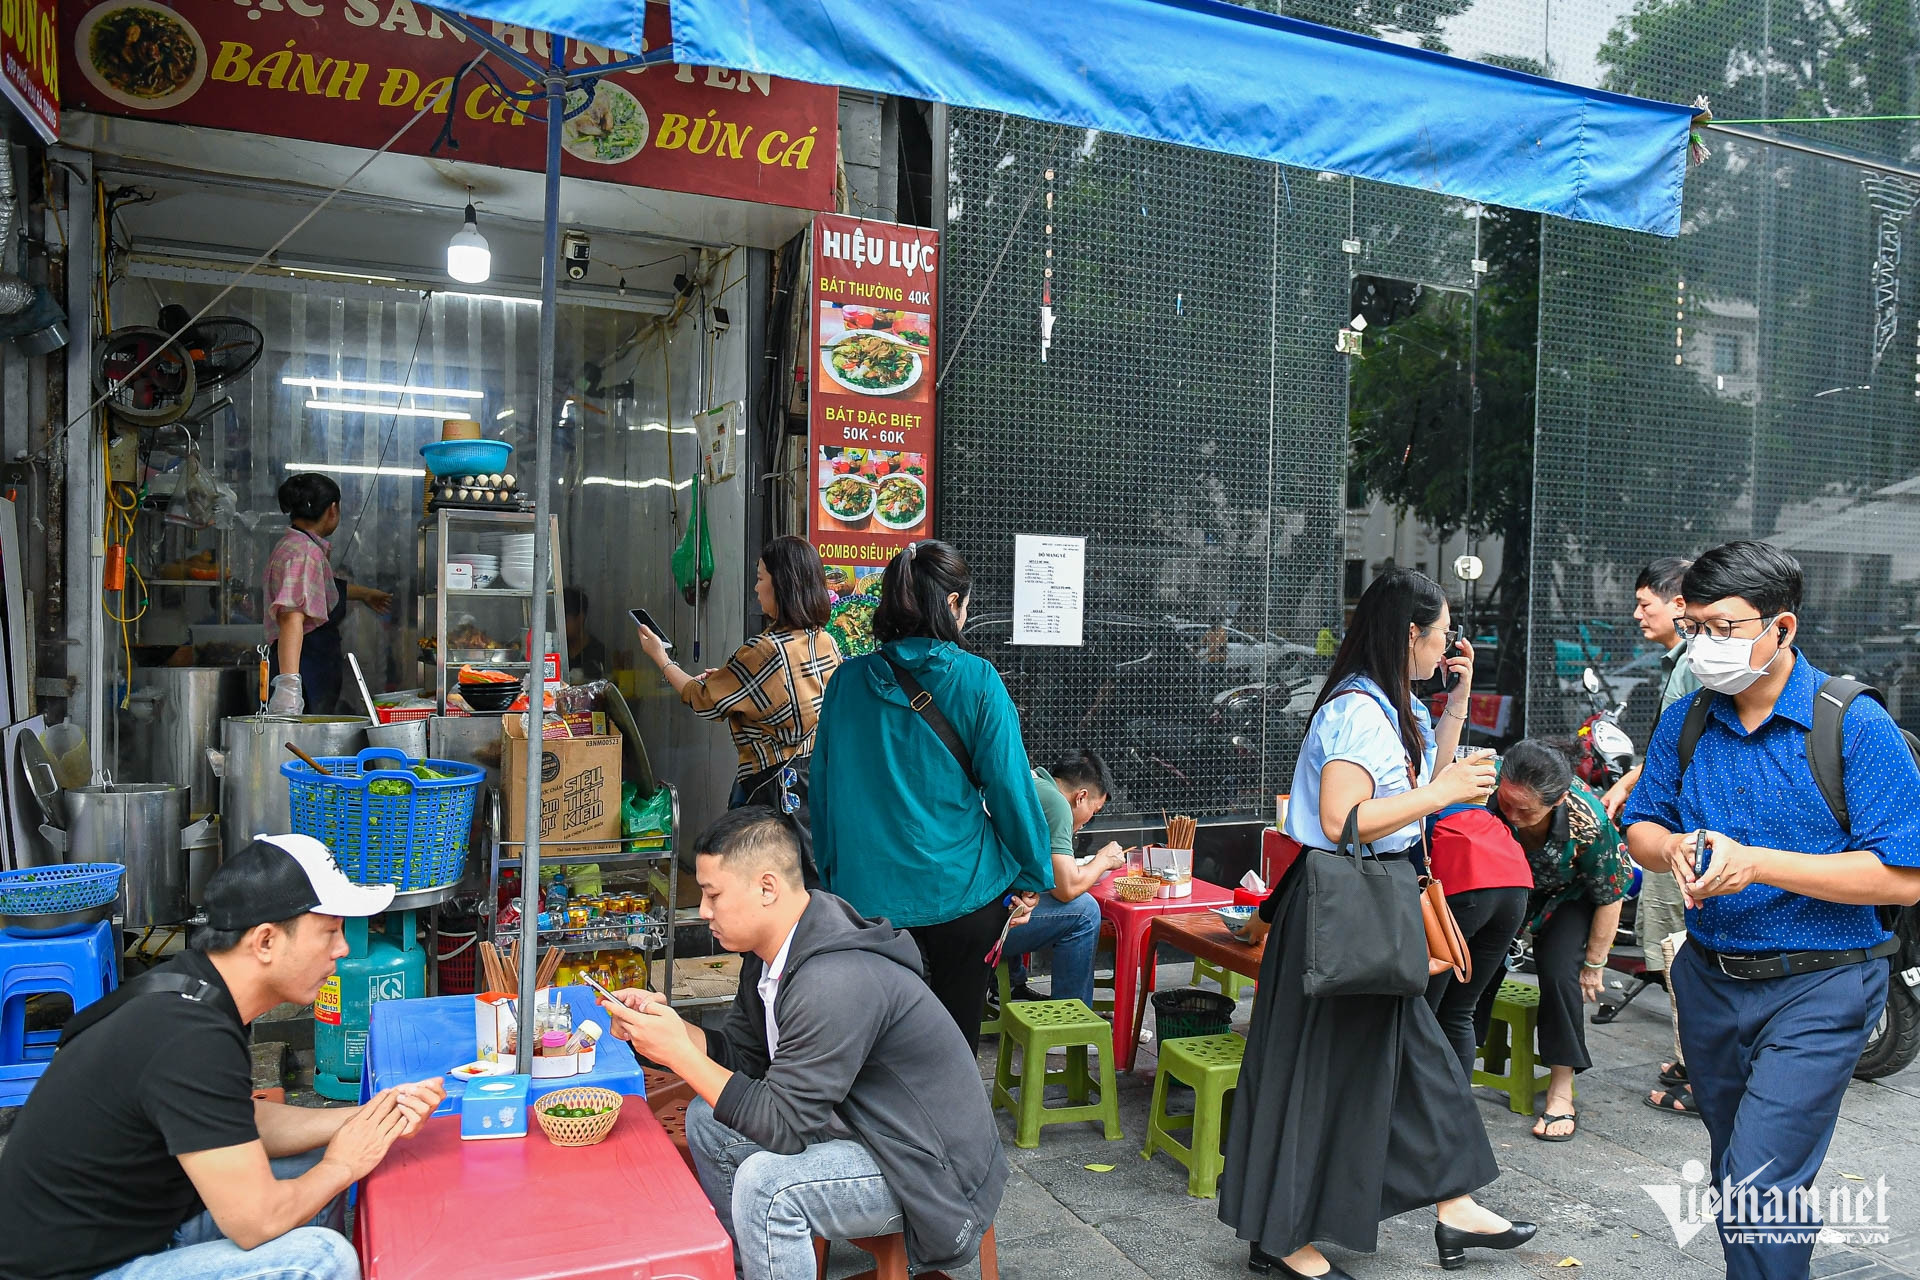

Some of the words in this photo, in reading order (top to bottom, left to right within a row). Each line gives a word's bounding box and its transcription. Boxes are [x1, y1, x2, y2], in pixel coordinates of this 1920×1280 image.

[211, 39, 369, 101] BÁNH
[378, 68, 456, 114] ĐA
[464, 80, 536, 126] CÁ
[655, 109, 753, 159] BÚN
[757, 126, 818, 169] CÁ
[823, 227, 884, 269] HIỆU
[889, 239, 935, 277] LỰC
[820, 276, 846, 294] BÁT
[848, 281, 903, 302] THƯỜNG
[908, 290, 931, 306] 40K
[825, 406, 854, 422] BÁT
[857, 410, 887, 428] ĐẶC
[890, 413, 922, 431] BIỆT
[843, 426, 869, 441] 50K
[879, 429, 905, 444] 60K
[818, 543, 858, 559] COMBO
[860, 542, 884, 560] SIÊU
[886, 543, 904, 561] HỜ
